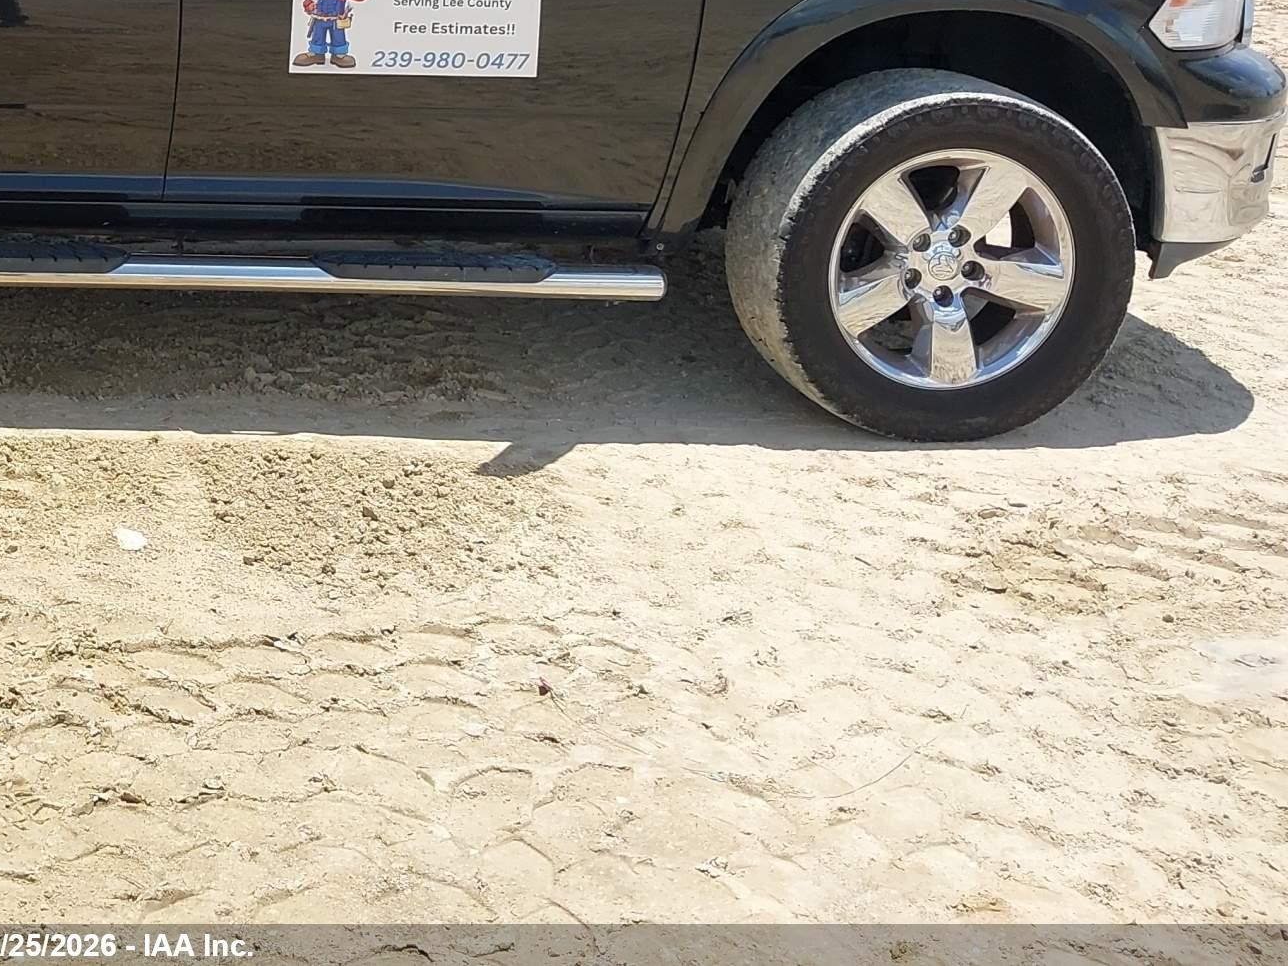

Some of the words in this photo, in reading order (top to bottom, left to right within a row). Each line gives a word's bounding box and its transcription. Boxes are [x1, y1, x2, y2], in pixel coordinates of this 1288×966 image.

[393, 21, 427, 34] Free
[431, 22, 516, 35] Estimates!!
[371, 50, 531, 70] 239-980-0477
